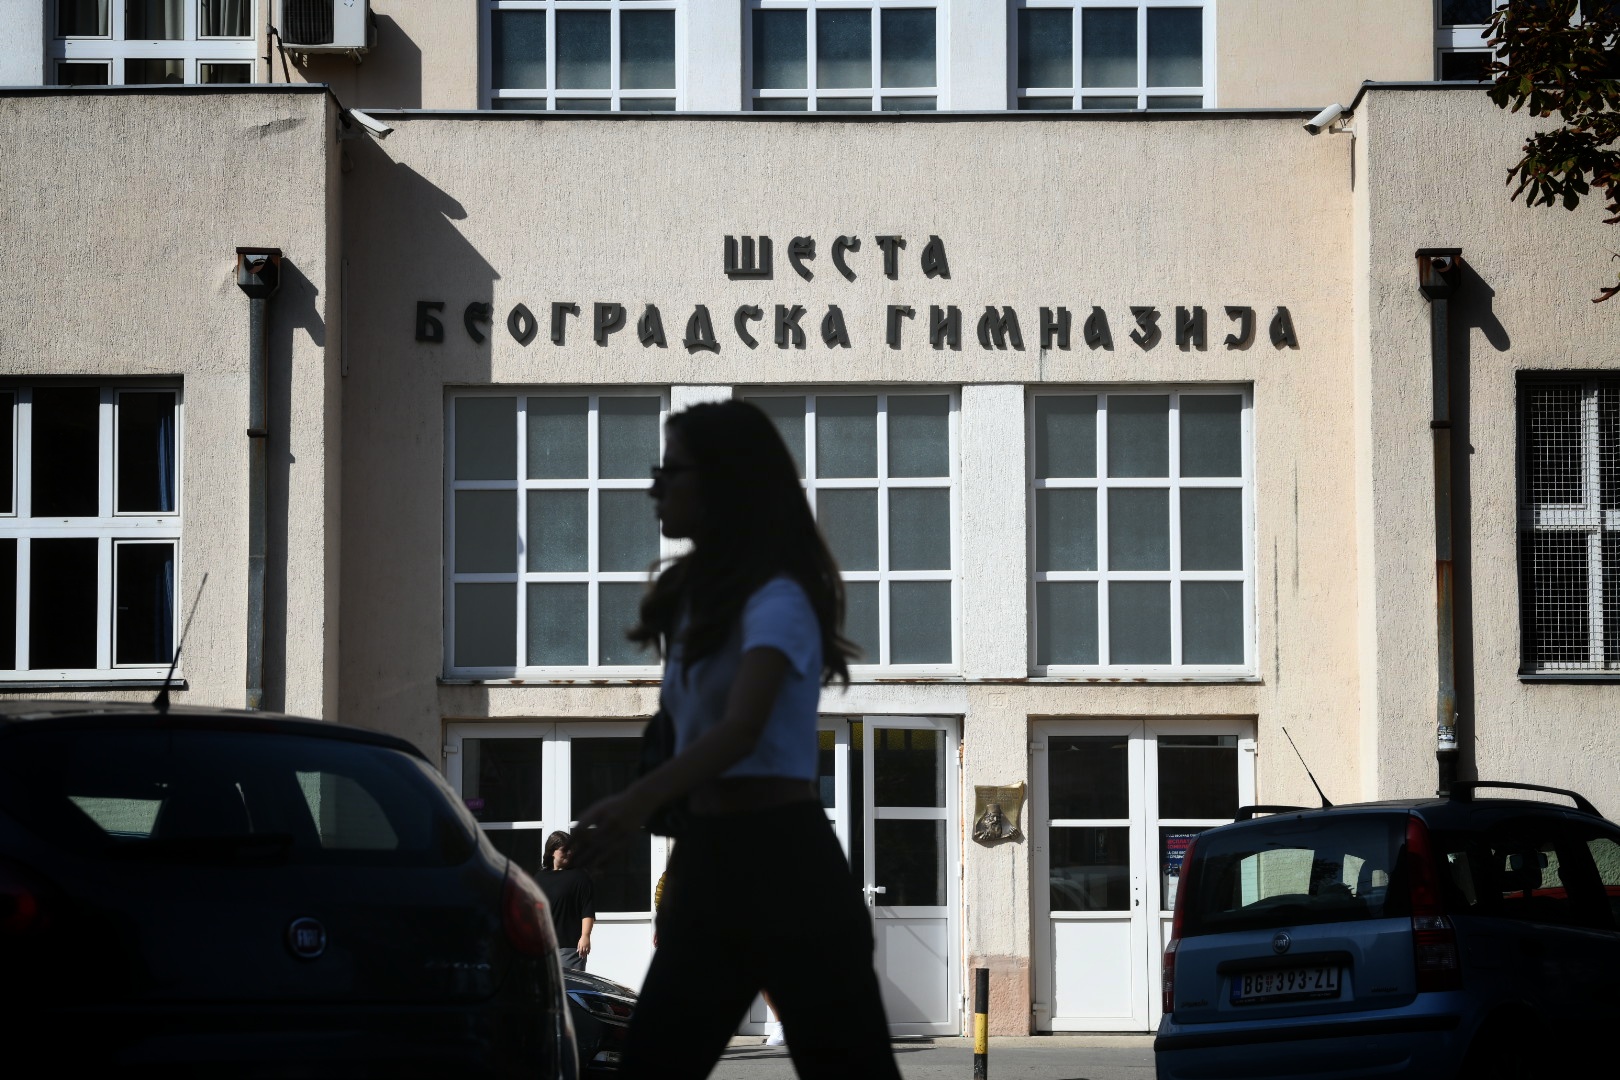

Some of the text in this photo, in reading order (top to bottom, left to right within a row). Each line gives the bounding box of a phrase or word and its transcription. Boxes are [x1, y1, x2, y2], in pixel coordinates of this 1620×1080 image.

[723, 235, 950, 281] ШЕСТА
[414, 301, 1300, 354] БЕОГРАДСКА ГИМНАЗИЈА
[1244, 974, 1264, 995] BG
